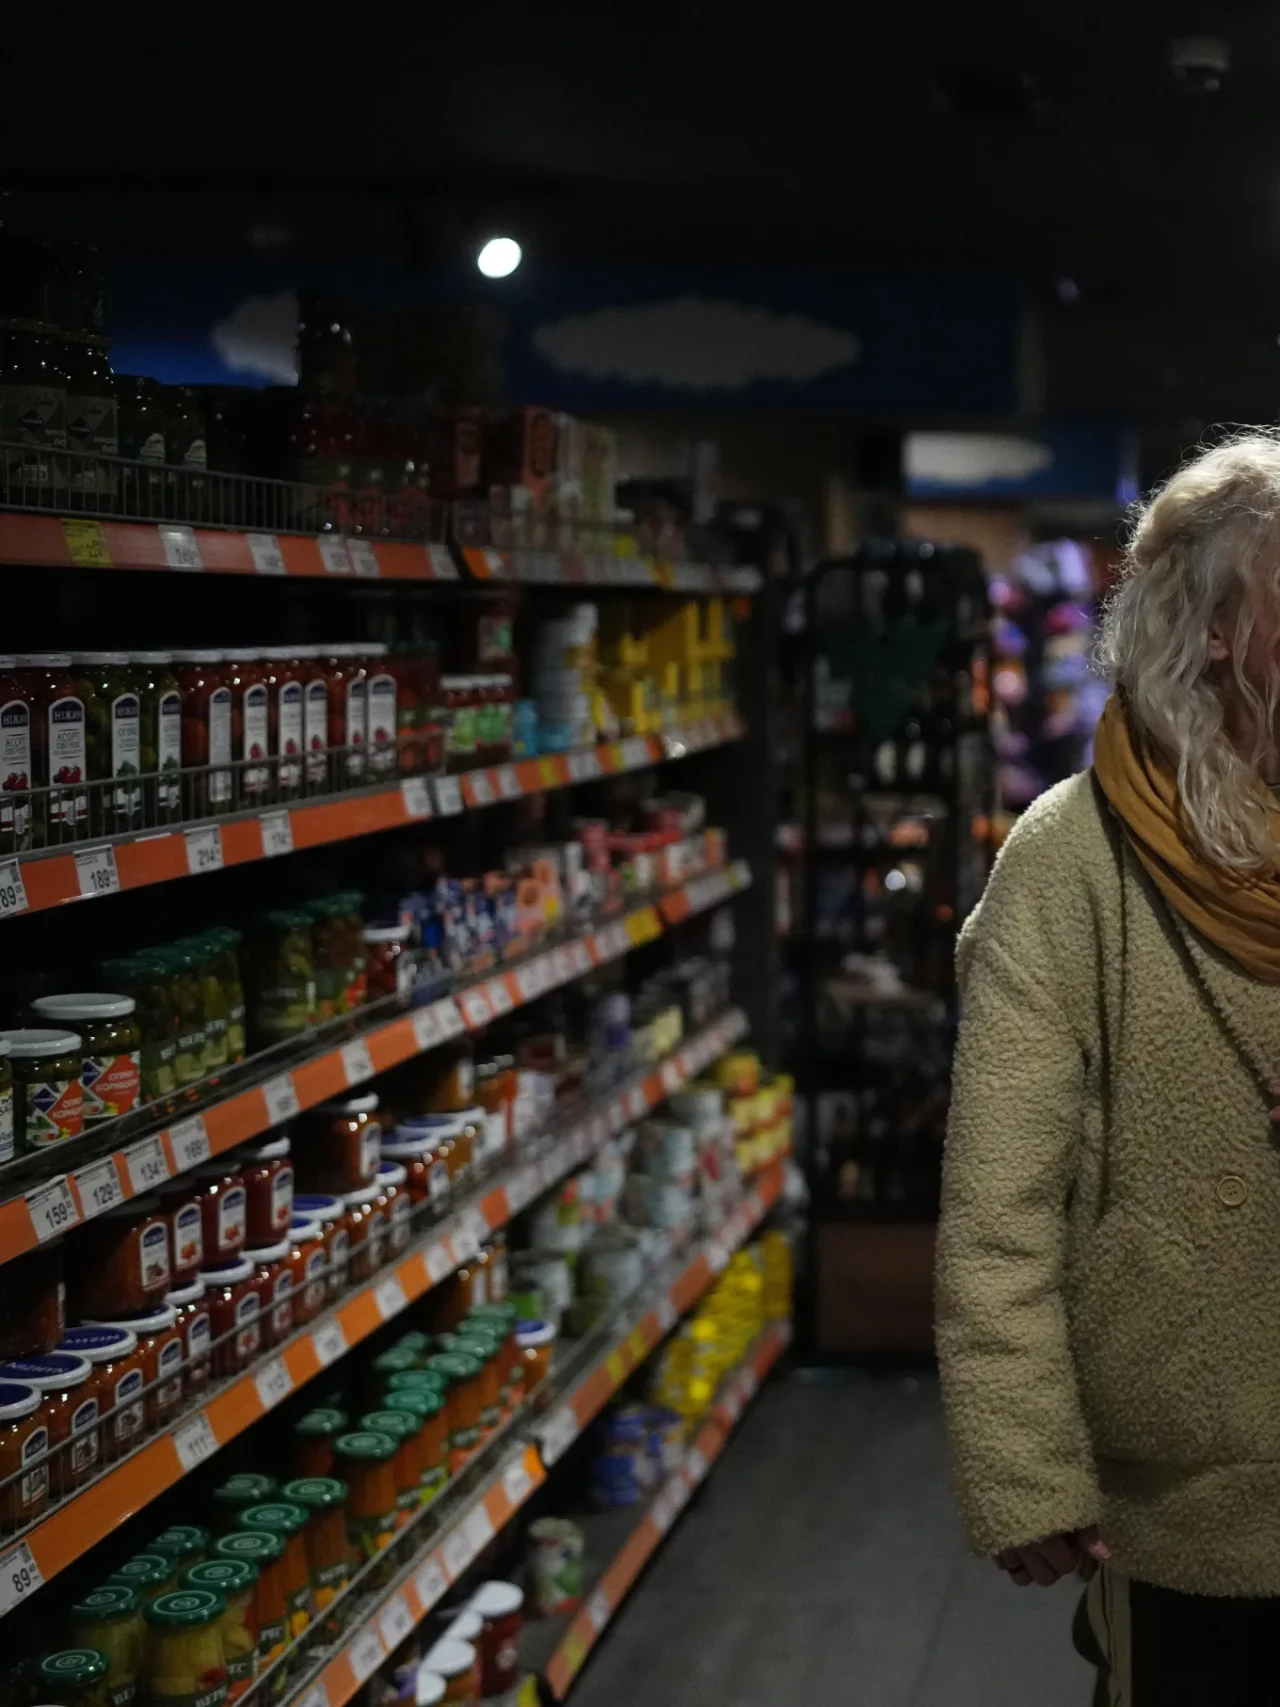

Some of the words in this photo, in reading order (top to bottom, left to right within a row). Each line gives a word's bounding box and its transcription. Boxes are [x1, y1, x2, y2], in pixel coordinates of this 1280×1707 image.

[90, 868, 110, 890] 189
[45, 1206, 68, 1229] 159
[12, 1568, 32, 1593] 89
